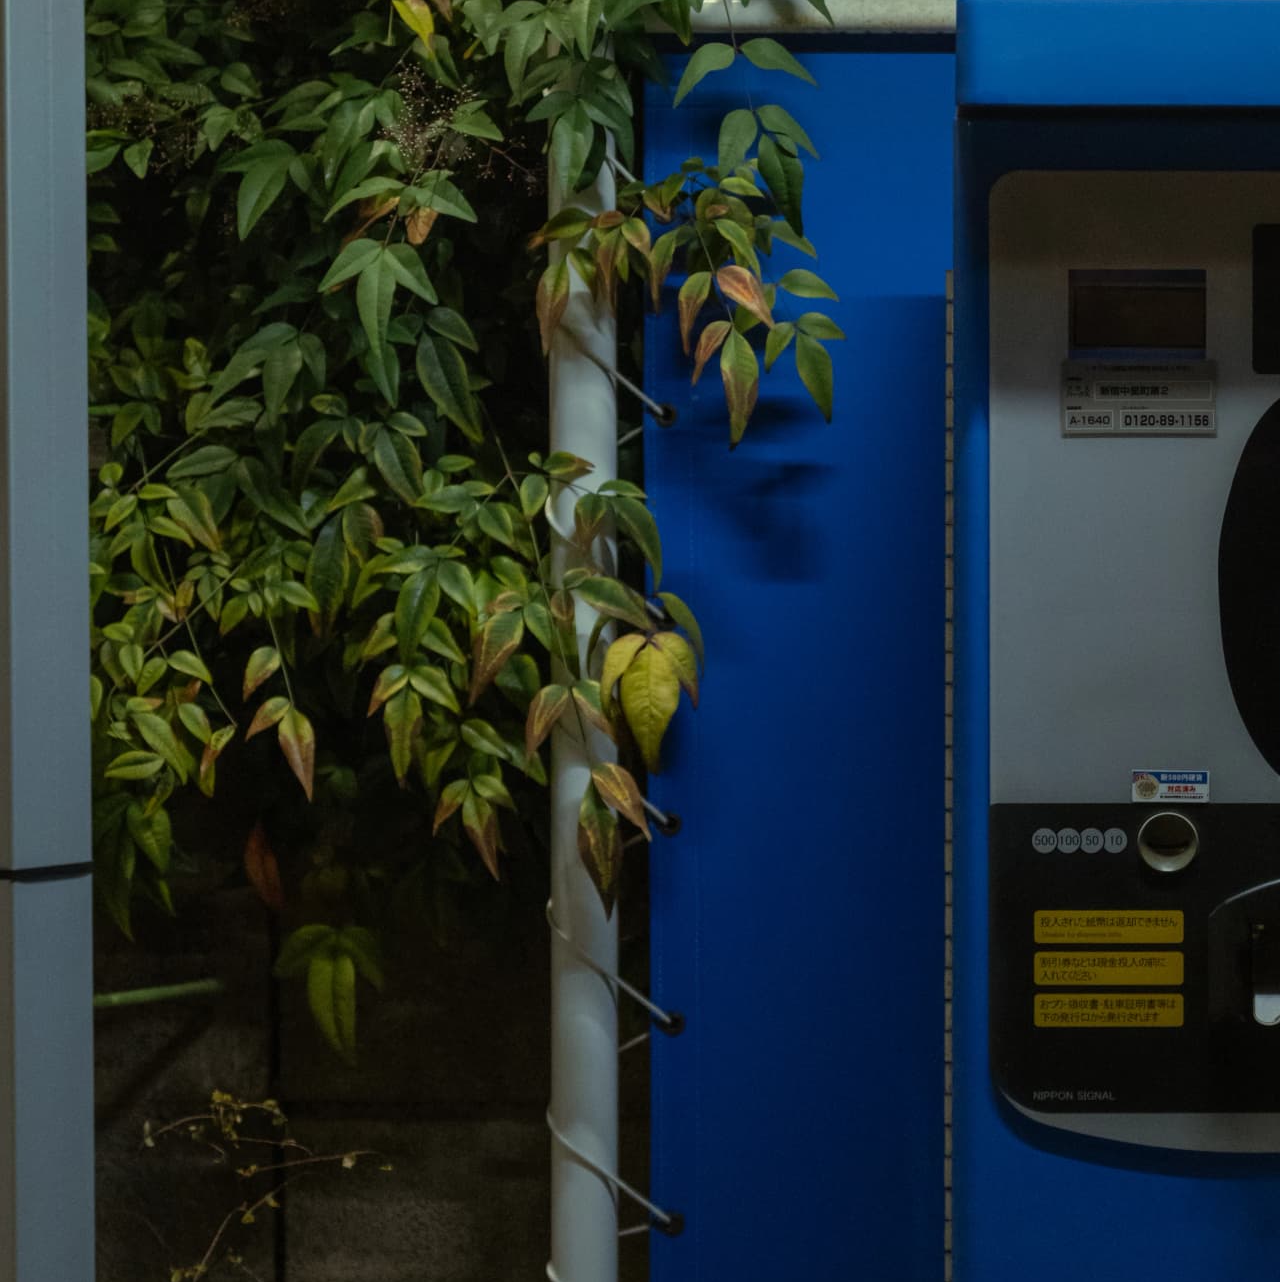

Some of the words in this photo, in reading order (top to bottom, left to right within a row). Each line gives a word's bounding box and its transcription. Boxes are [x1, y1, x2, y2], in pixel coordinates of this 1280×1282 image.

[1035, 835, 1055, 846] 500
[1060, 835, 1079, 846] 100
[1086, 835, 1098, 846] 50
[1110, 835, 1122, 846] 10
[1033, 1090, 1073, 1101] NIPPON
[1077, 1090, 1118, 1101] SIGNAL
